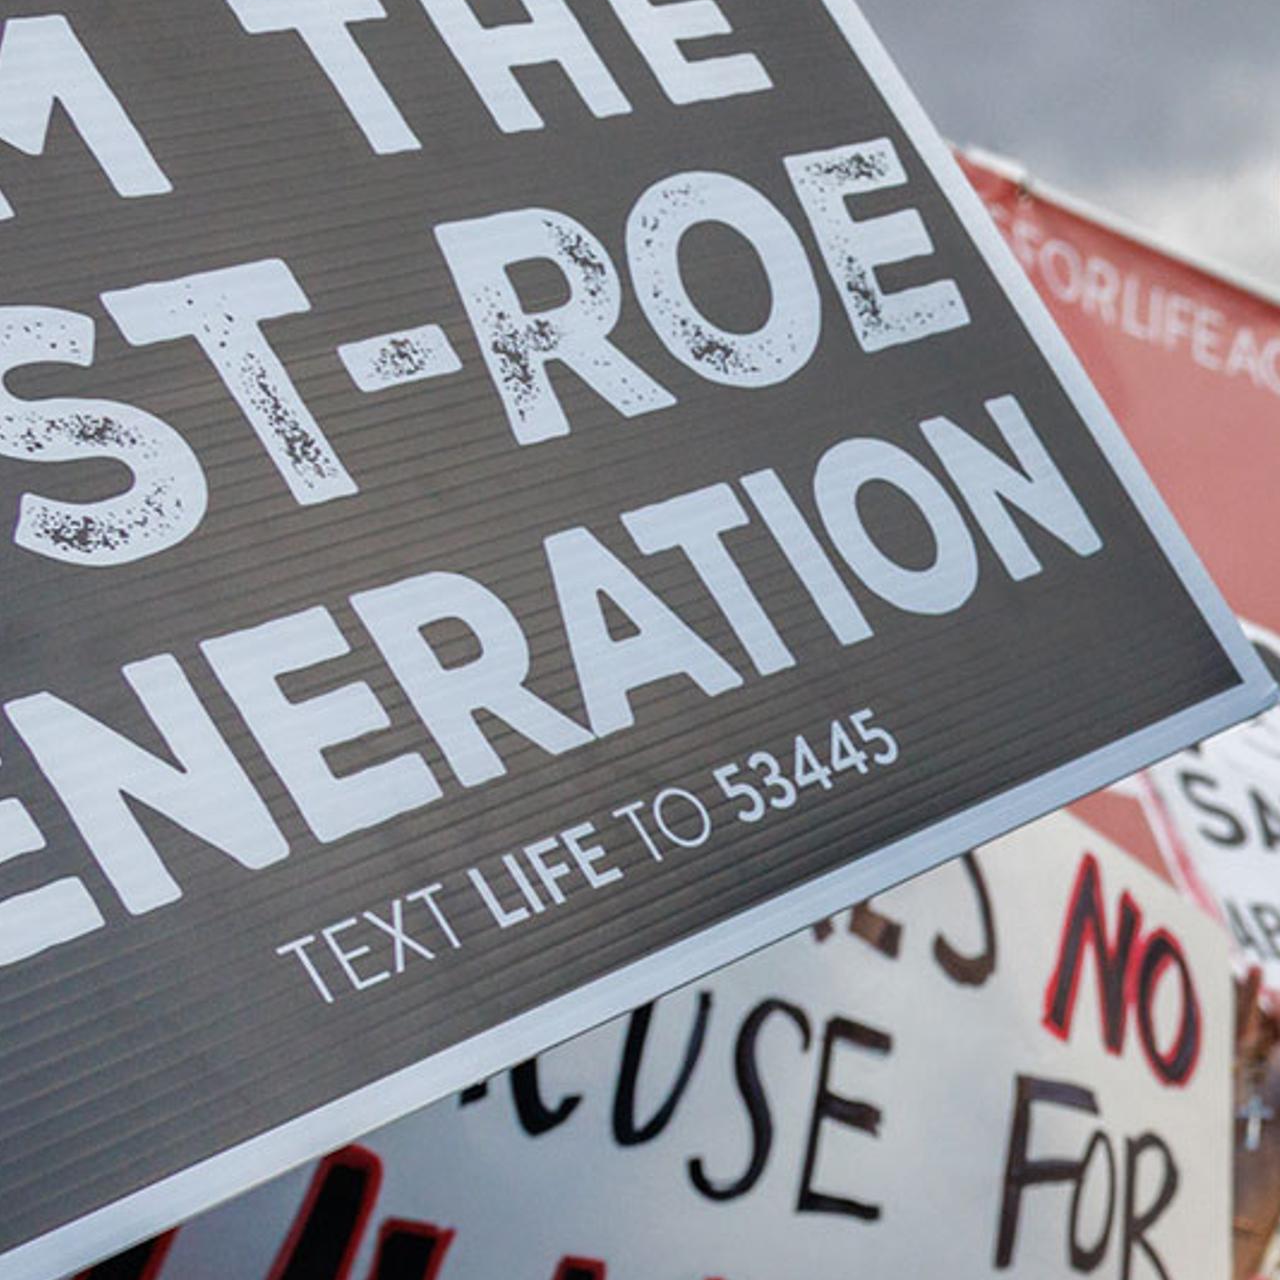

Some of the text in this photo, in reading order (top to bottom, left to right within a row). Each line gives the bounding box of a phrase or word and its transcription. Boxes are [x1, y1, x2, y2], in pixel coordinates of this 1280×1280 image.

[0, 137, 971, 567] ST-ROE
[276, 708, 900, 1003] TEXT LIFE TO 53445
[1041, 852, 1202, 1089] NO
